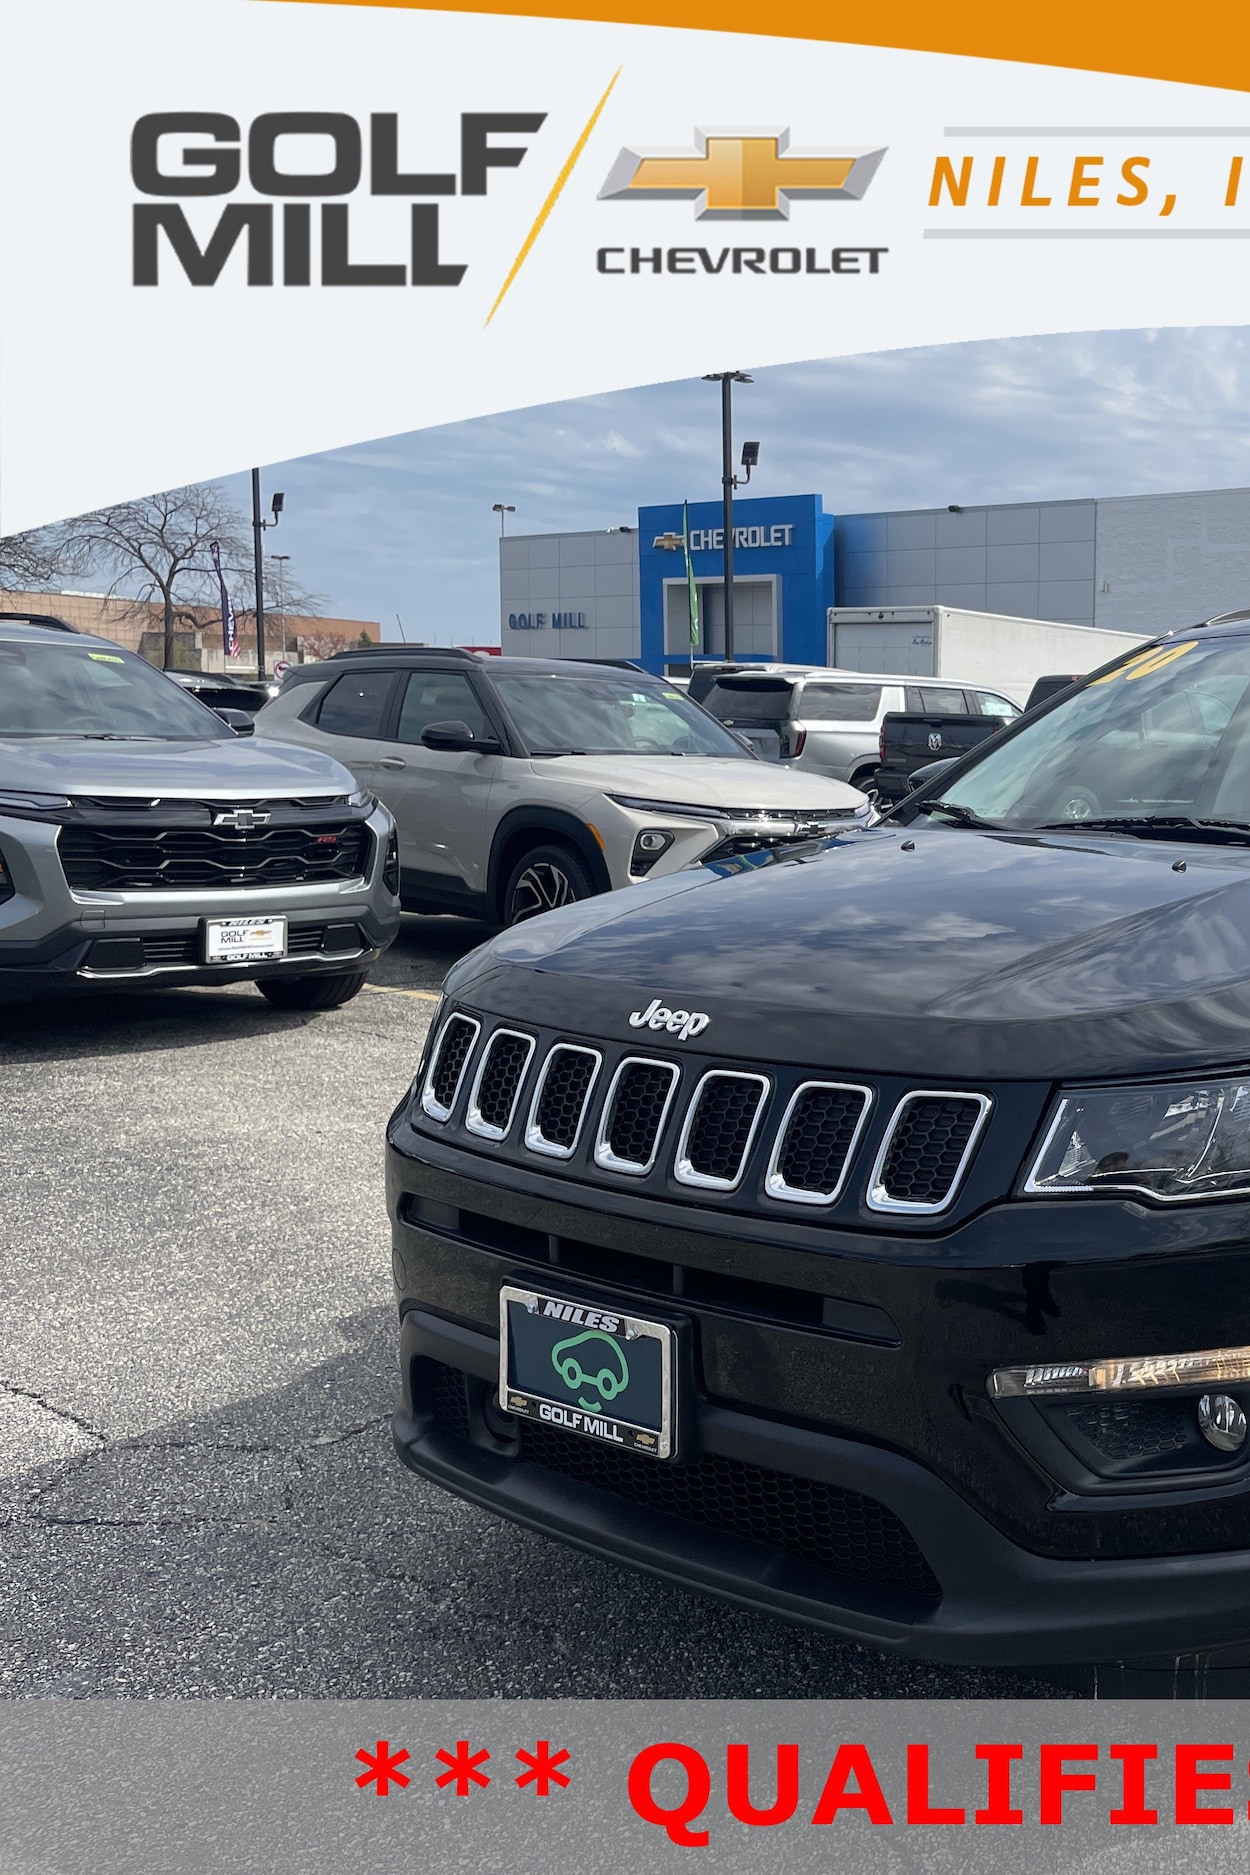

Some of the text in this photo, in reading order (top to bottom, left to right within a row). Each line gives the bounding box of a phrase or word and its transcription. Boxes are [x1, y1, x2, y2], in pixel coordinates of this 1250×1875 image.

[690, 523, 794, 551] CHEROLET
[508, 612, 585, 630] GOLF MILL
[629, 999, 711, 1041] Jeep
[543, 1301, 620, 1333] NILES
[538, 1403, 624, 1443] GOLF MILL
